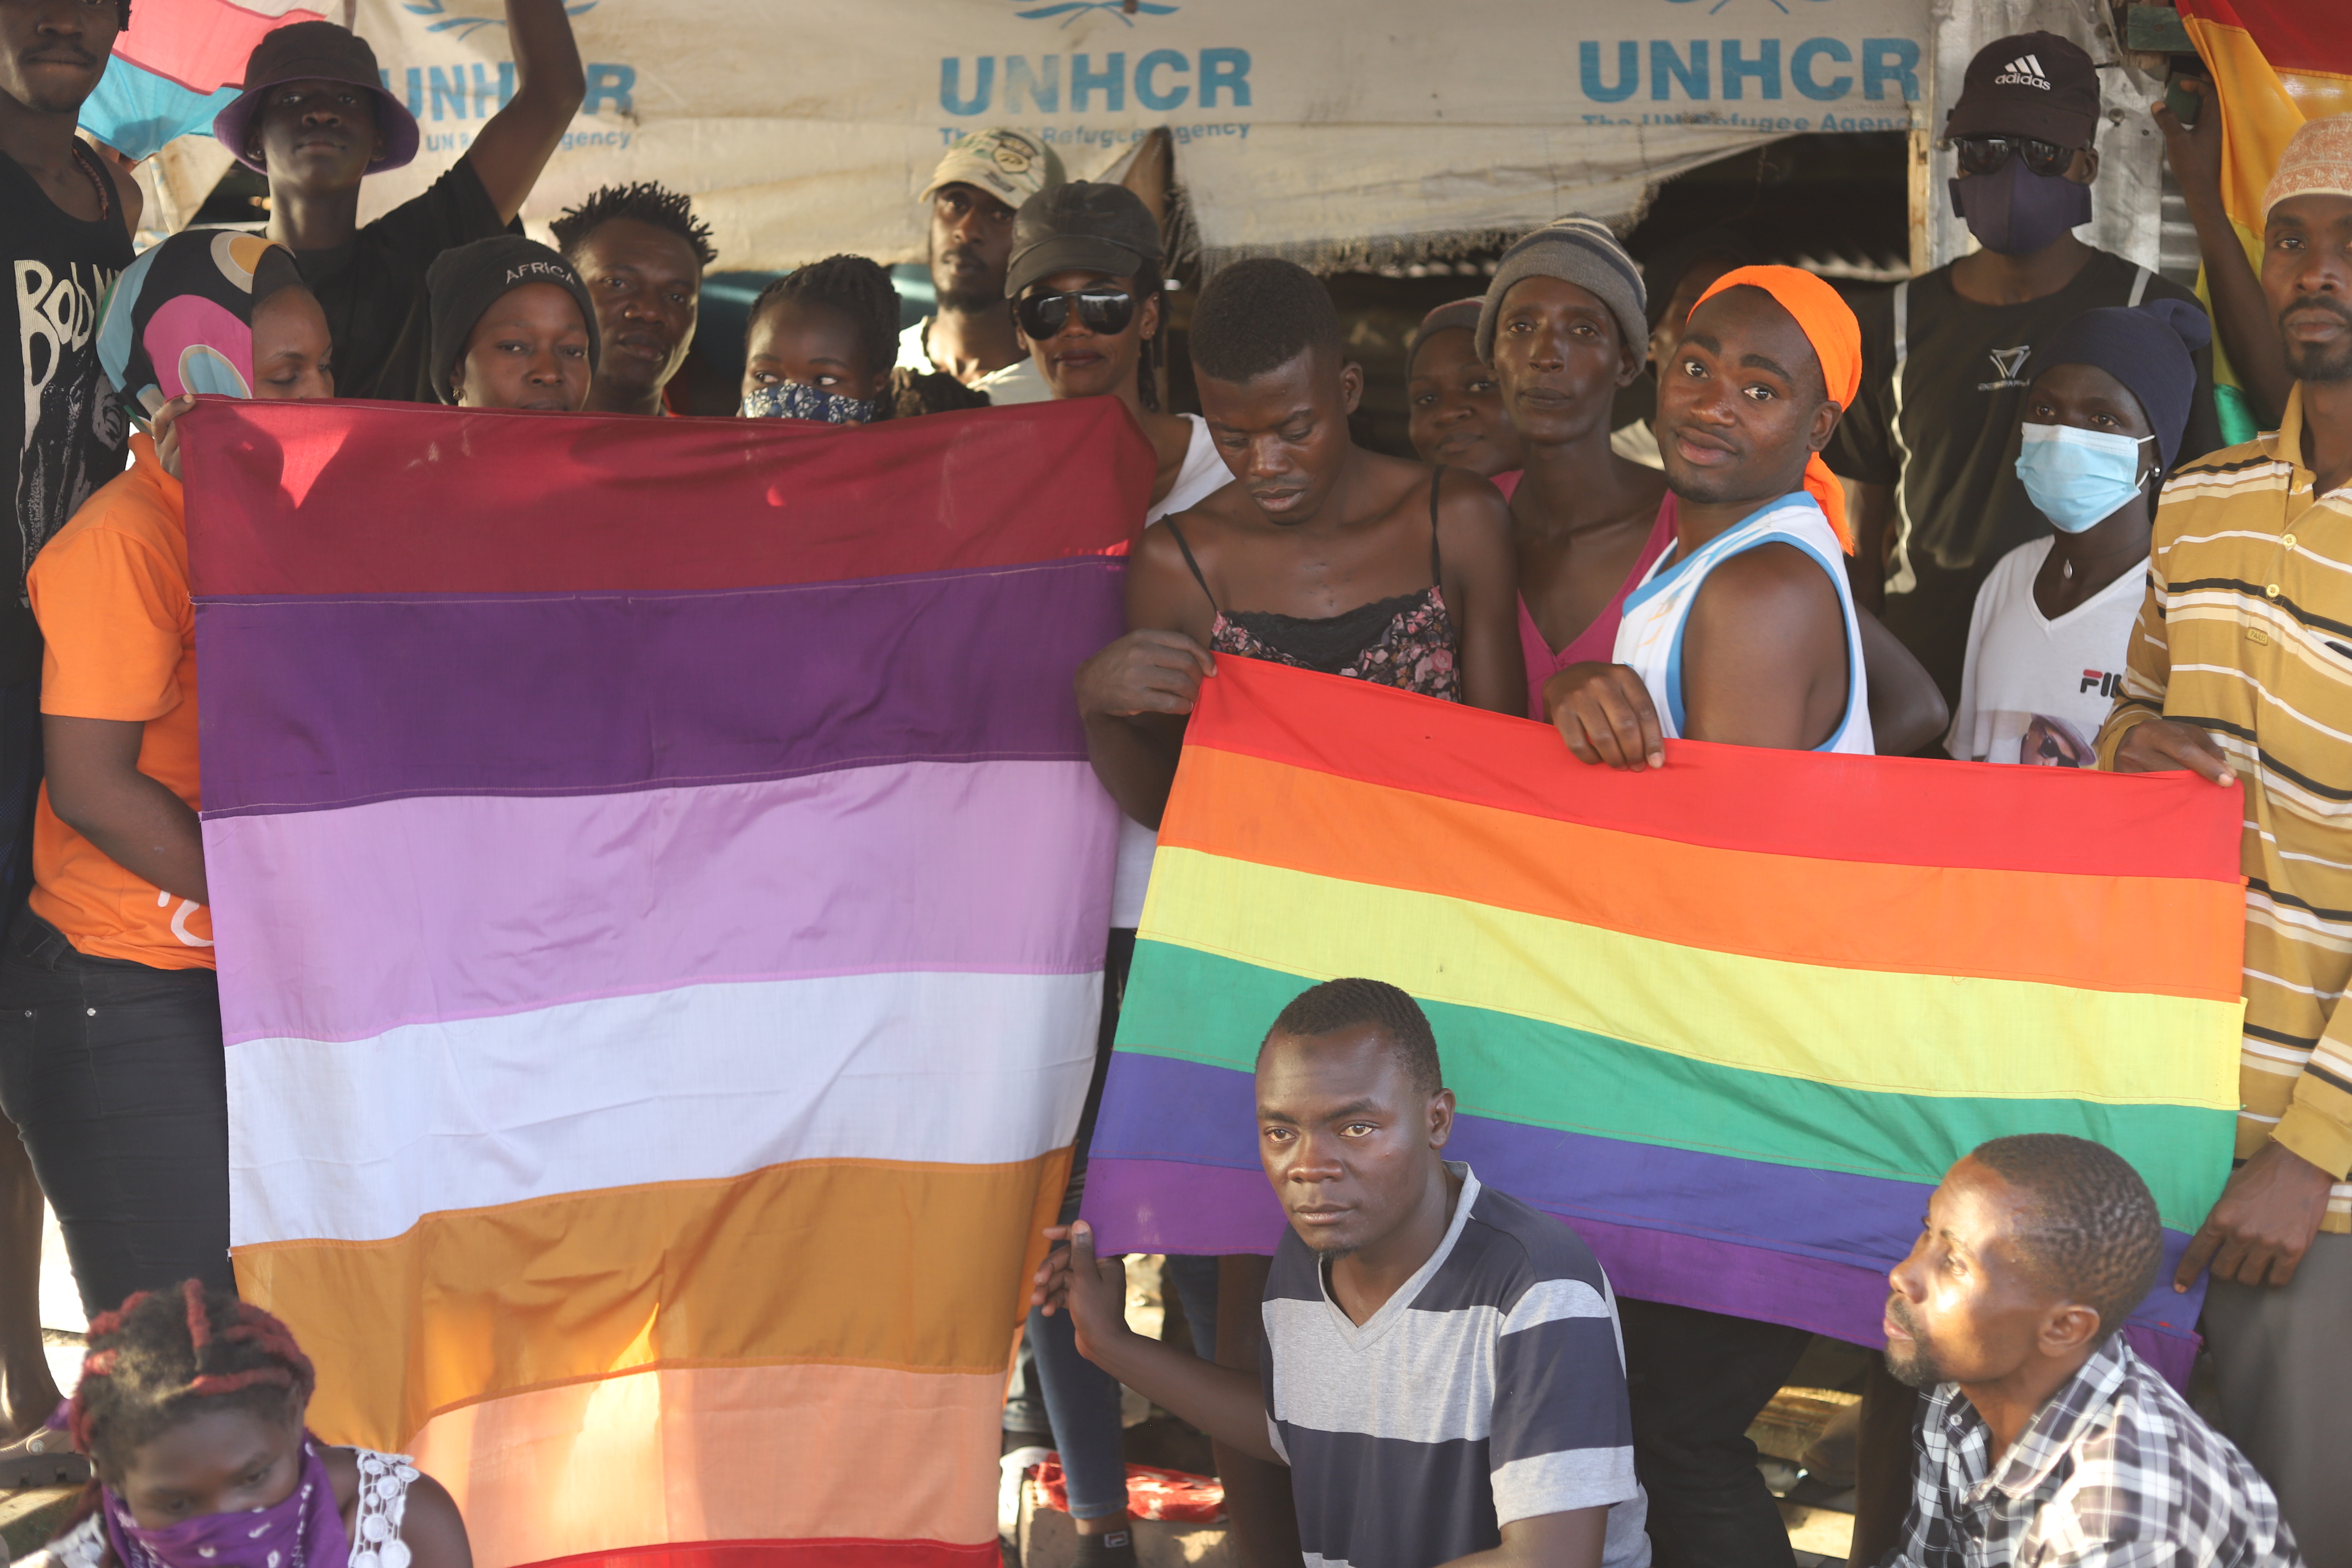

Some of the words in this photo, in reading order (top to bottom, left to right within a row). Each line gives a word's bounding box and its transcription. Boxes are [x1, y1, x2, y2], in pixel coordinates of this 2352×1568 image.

[940, 47, 1252, 116] UNHCR
[1579, 37, 1921, 103] UNHCR
[1995, 72, 2051, 91] adidas
[378, 61, 636, 121] UNHR
[427, 133, 454, 151] UN
[561, 131, 631, 151] gency
[1161, 123, 1251, 144] gency
[506, 262, 577, 287] AFRICA
[2251, 631, 2266, 642] PARIS
